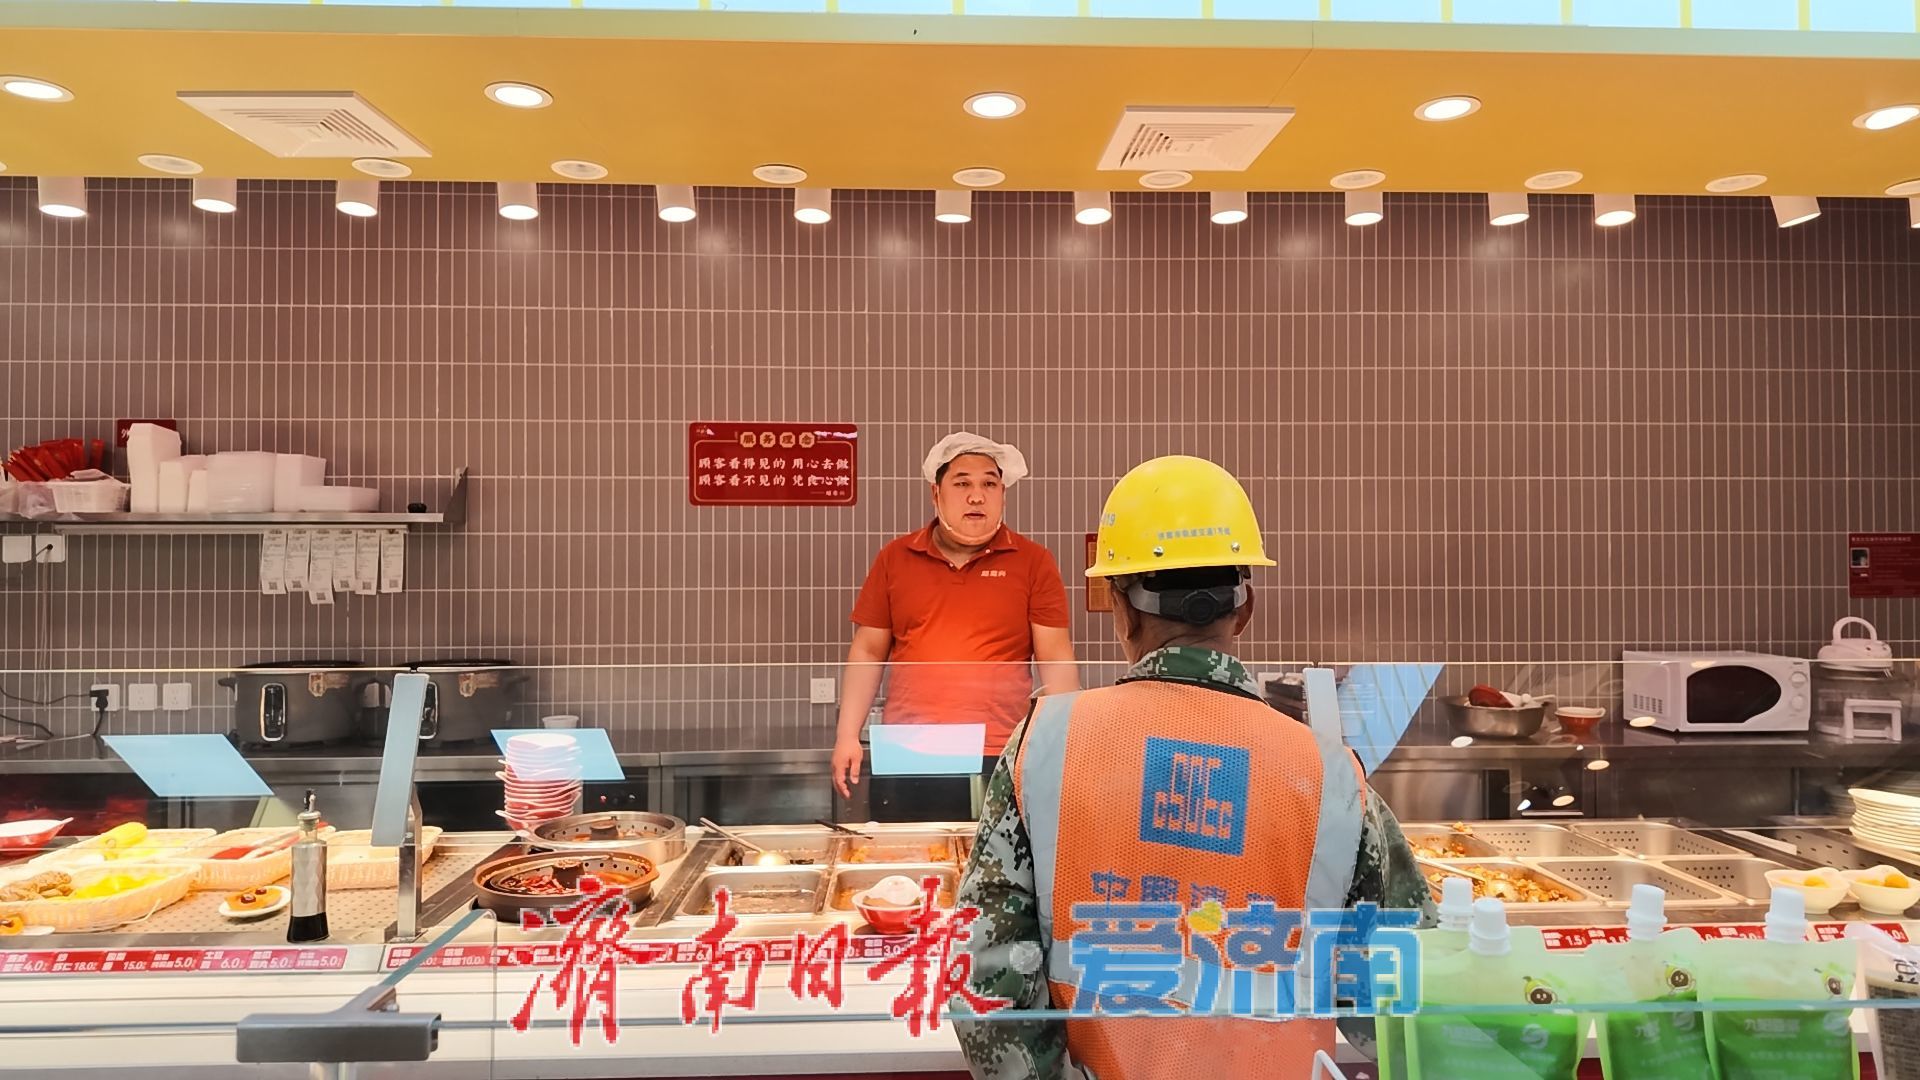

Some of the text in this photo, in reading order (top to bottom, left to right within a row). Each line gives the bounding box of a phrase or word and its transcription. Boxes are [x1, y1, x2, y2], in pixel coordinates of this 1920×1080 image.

[743, 433, 813, 446] 服务理念
[174, 957, 193, 968] 5.0
[220, 958, 241, 969] 6.0
[270, 957, 289, 968] 5.0
[320, 956, 338, 967] 5.0
